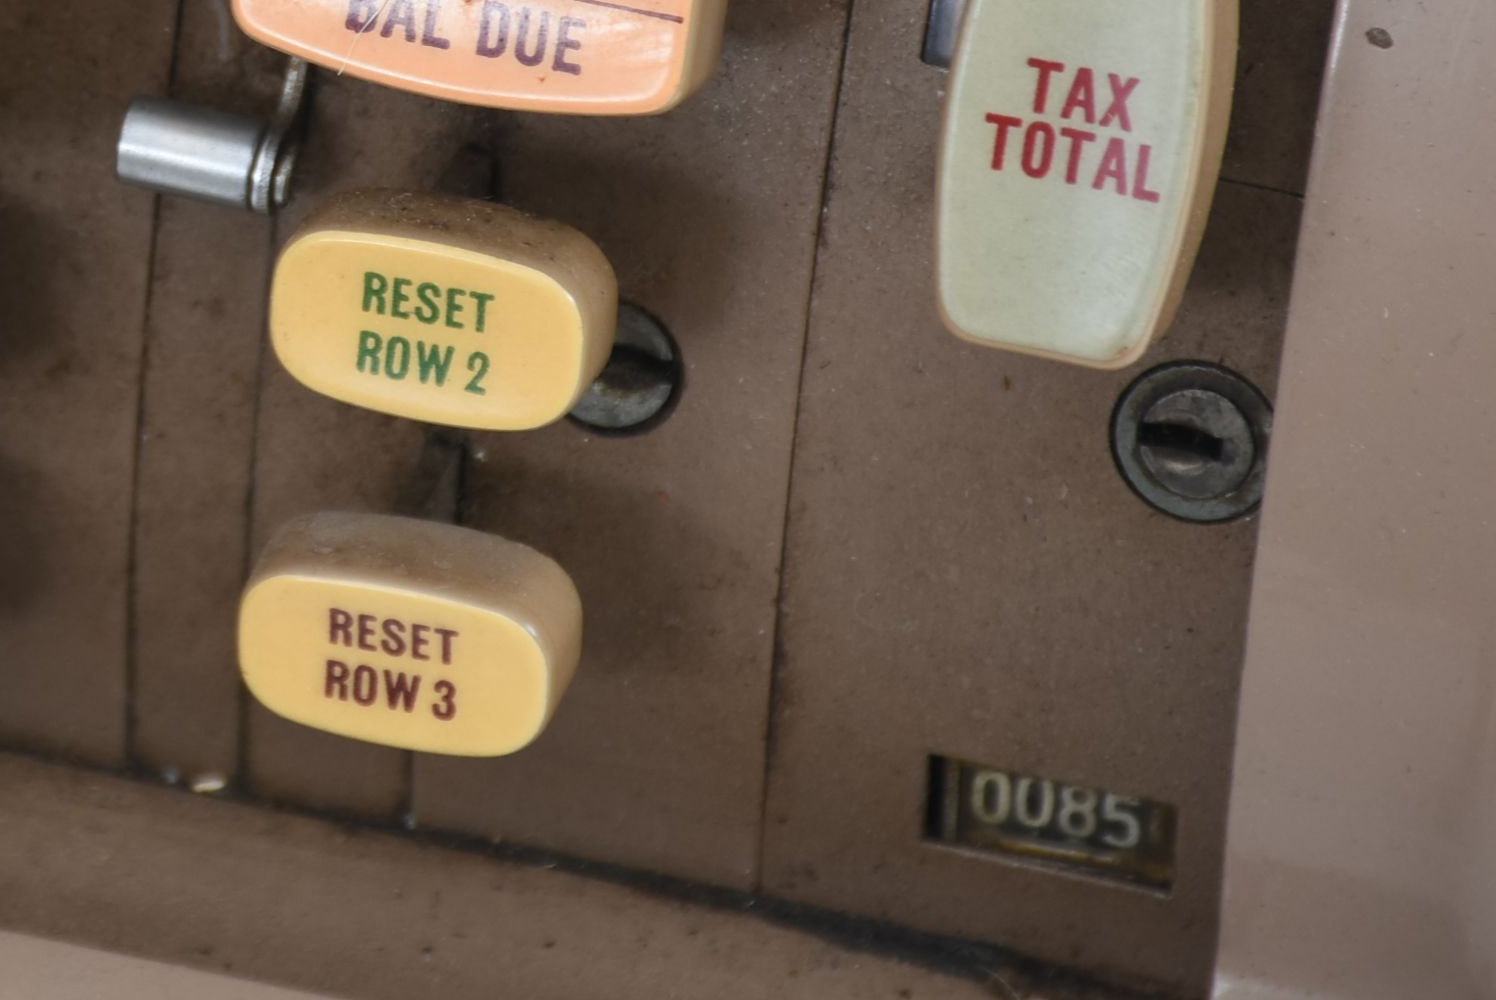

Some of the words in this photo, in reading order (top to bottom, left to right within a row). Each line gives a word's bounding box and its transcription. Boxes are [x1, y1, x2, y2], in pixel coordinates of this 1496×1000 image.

[474, 1, 585, 77] DUE
[1025, 56, 1139, 133] TAX
[984, 112, 1161, 203] TOTAL
[360, 270, 495, 336] RESET
[354, 329, 456, 387] ROW
[463, 351, 492, 395] 2
[328, 606, 459, 667] RESET
[323, 659, 420, 712] ROW
[430, 680, 458, 723] 3
[971, 770, 1141, 848] 0085
